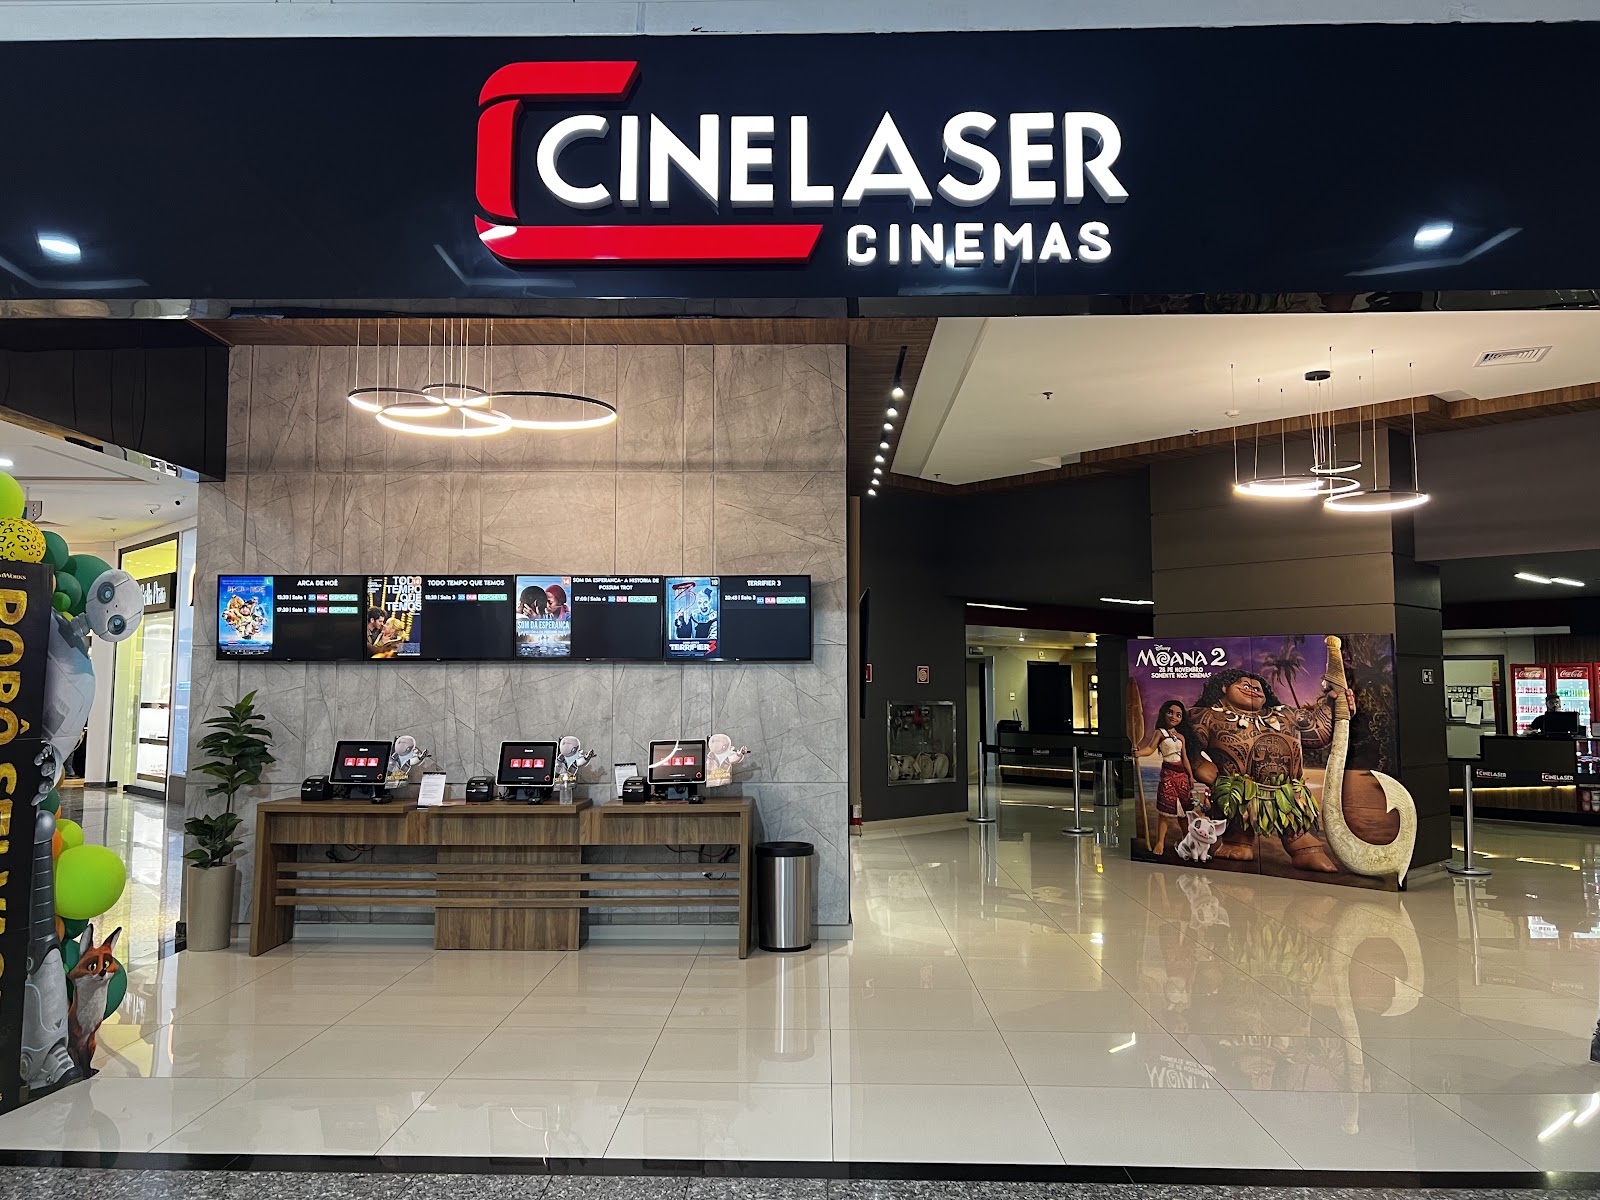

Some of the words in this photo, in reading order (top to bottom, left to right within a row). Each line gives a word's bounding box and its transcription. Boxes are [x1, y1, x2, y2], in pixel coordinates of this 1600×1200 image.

[536, 111, 1129, 213] CINELASER
[847, 221, 1112, 267] CINEMAS
[324, 578, 339, 586] NOÉ
[386, 585, 422, 594] TEMPO
[400, 593, 422, 602] QUE
[386, 602, 422, 611] TEMOS
[517, 620, 529, 629] SOM
[530, 620, 538, 629] DA
[538, 620, 570, 630] ESPERANÇA
[669, 643, 710, 652] TERRIFIER
[705, 640, 718, 656] 3
[1153, 644, 1171, 652] Disney
[1135, 648, 1208, 667] MOANA
[1210, 647, 1228, 667] 2
[1560, 669, 1584, 678] Coca-Cola
[1478, 770, 1507, 778] CINELASER
